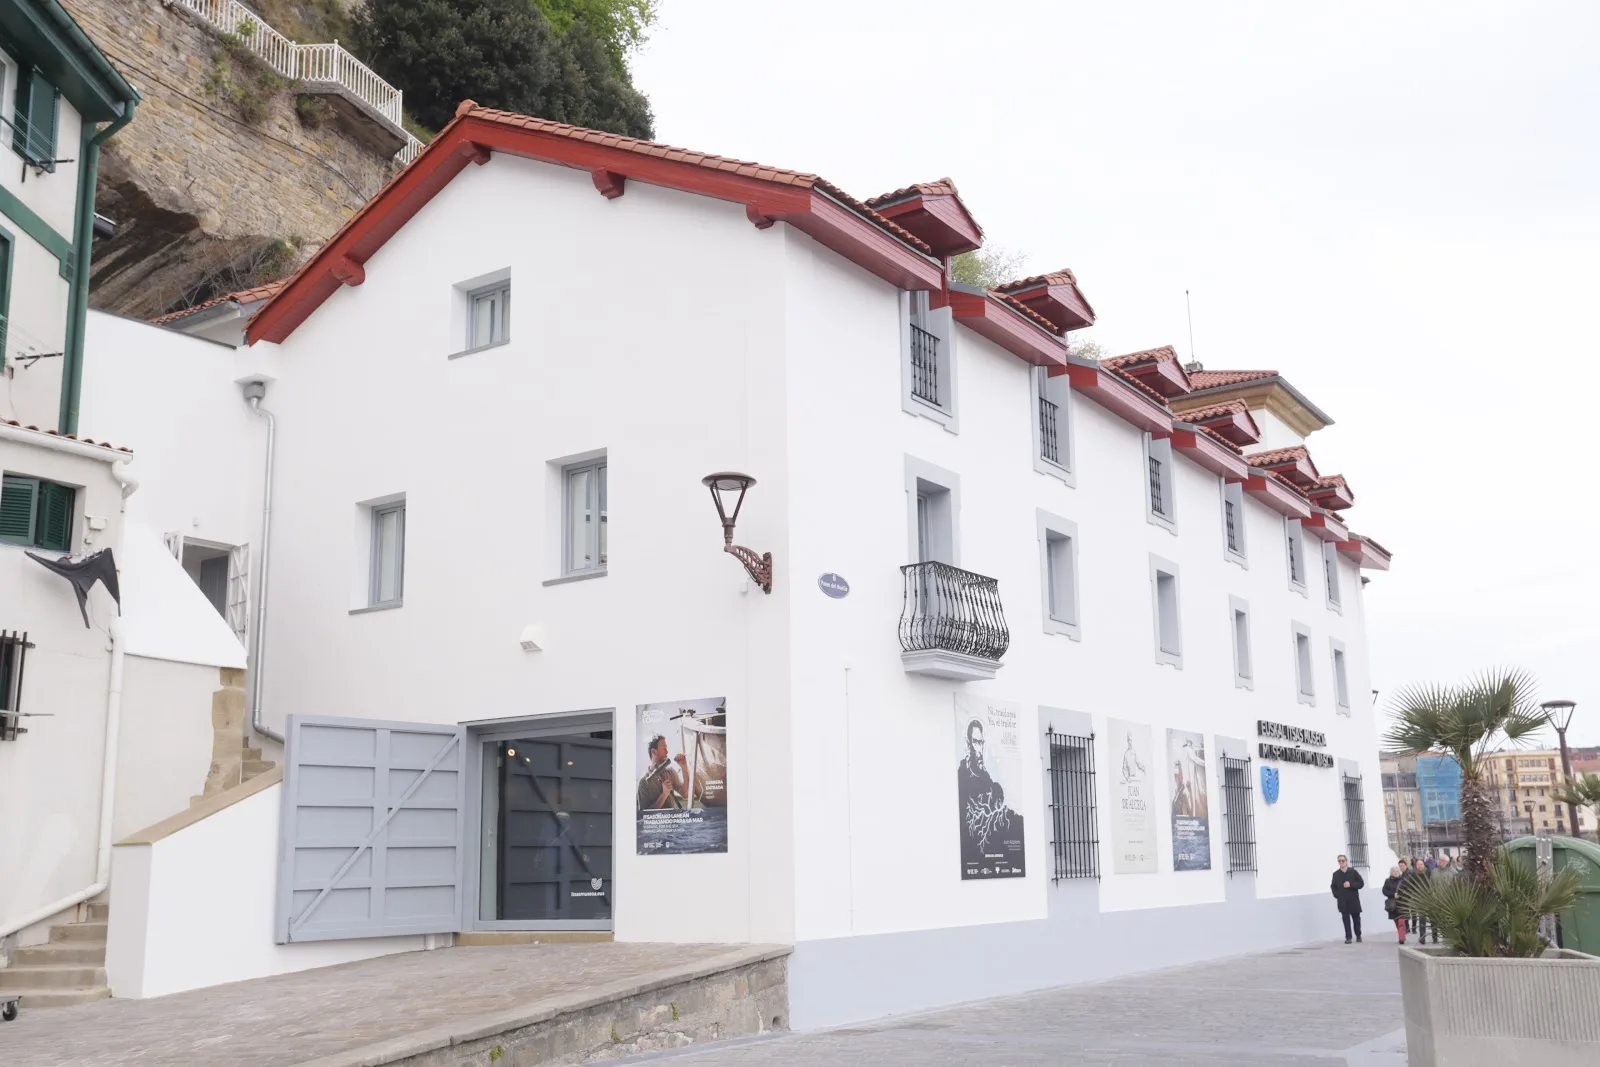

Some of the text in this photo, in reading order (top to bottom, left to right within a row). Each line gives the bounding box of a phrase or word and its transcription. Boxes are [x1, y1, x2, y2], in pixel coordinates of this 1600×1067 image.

[1258, 720, 1285, 738] EUSKAL
[1286, 725, 1304, 742] ITSAS
[1259, 743, 1285, 761] MUSEO
[1128, 786, 1140, 798] JUAN
[1122, 798, 1128, 809] DE
